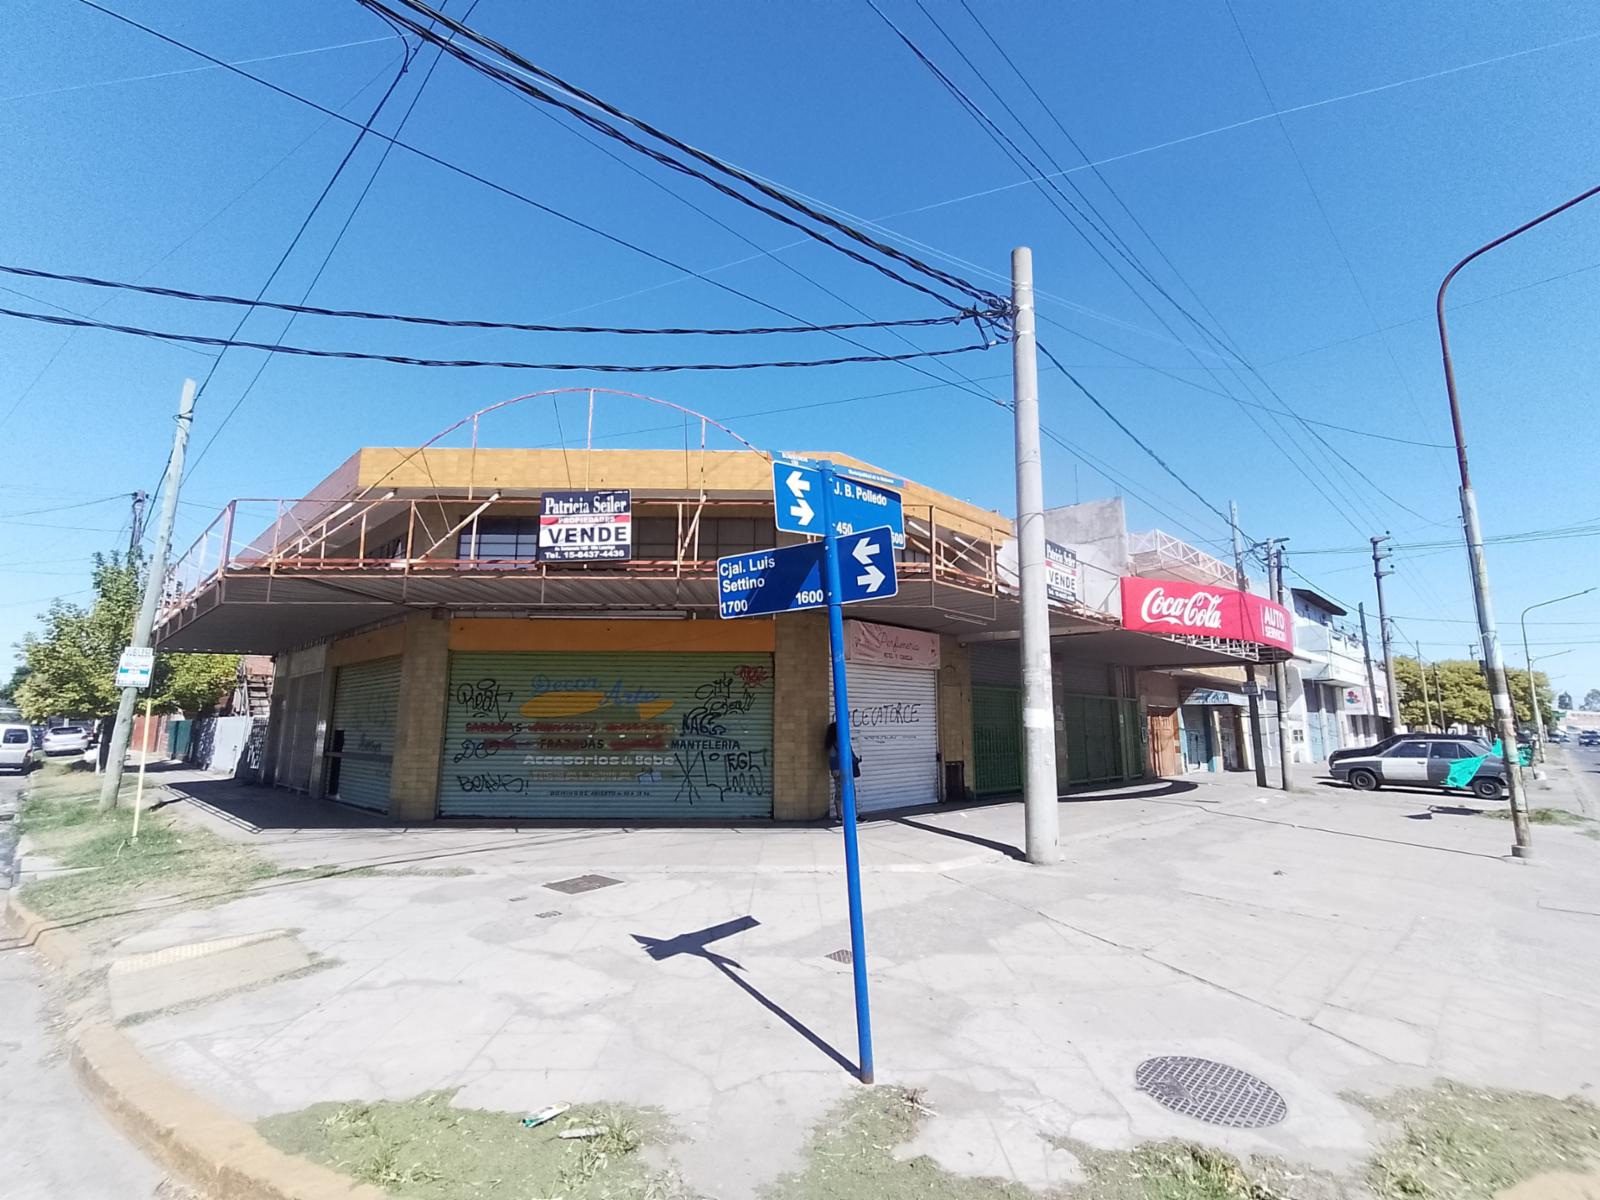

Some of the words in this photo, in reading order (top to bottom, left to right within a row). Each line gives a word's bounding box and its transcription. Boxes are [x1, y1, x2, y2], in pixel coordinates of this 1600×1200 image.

[544, 496, 590, 515] Patricia
[593, 495, 627, 514] Seiler
[834, 481, 843, 496] J.
[844, 484, 854, 499] B.
[856, 487, 887, 507] Polledo
[548, 526, 627, 544] VENDE
[836, 522, 853, 536] 450
[720, 560, 746, 579] Cjal.
[749, 556, 775, 572] Luis
[722, 577, 765, 593] Settino
[1049, 569, 1076, 591] VENDE
[721, 599, 748, 614] 1700
[795, 589, 824, 604] 1600
[1141, 587, 1223, 629] Coca-Cola
[1264, 605, 1285, 630] AUTO
[523, 755, 620, 766] Accesorios
